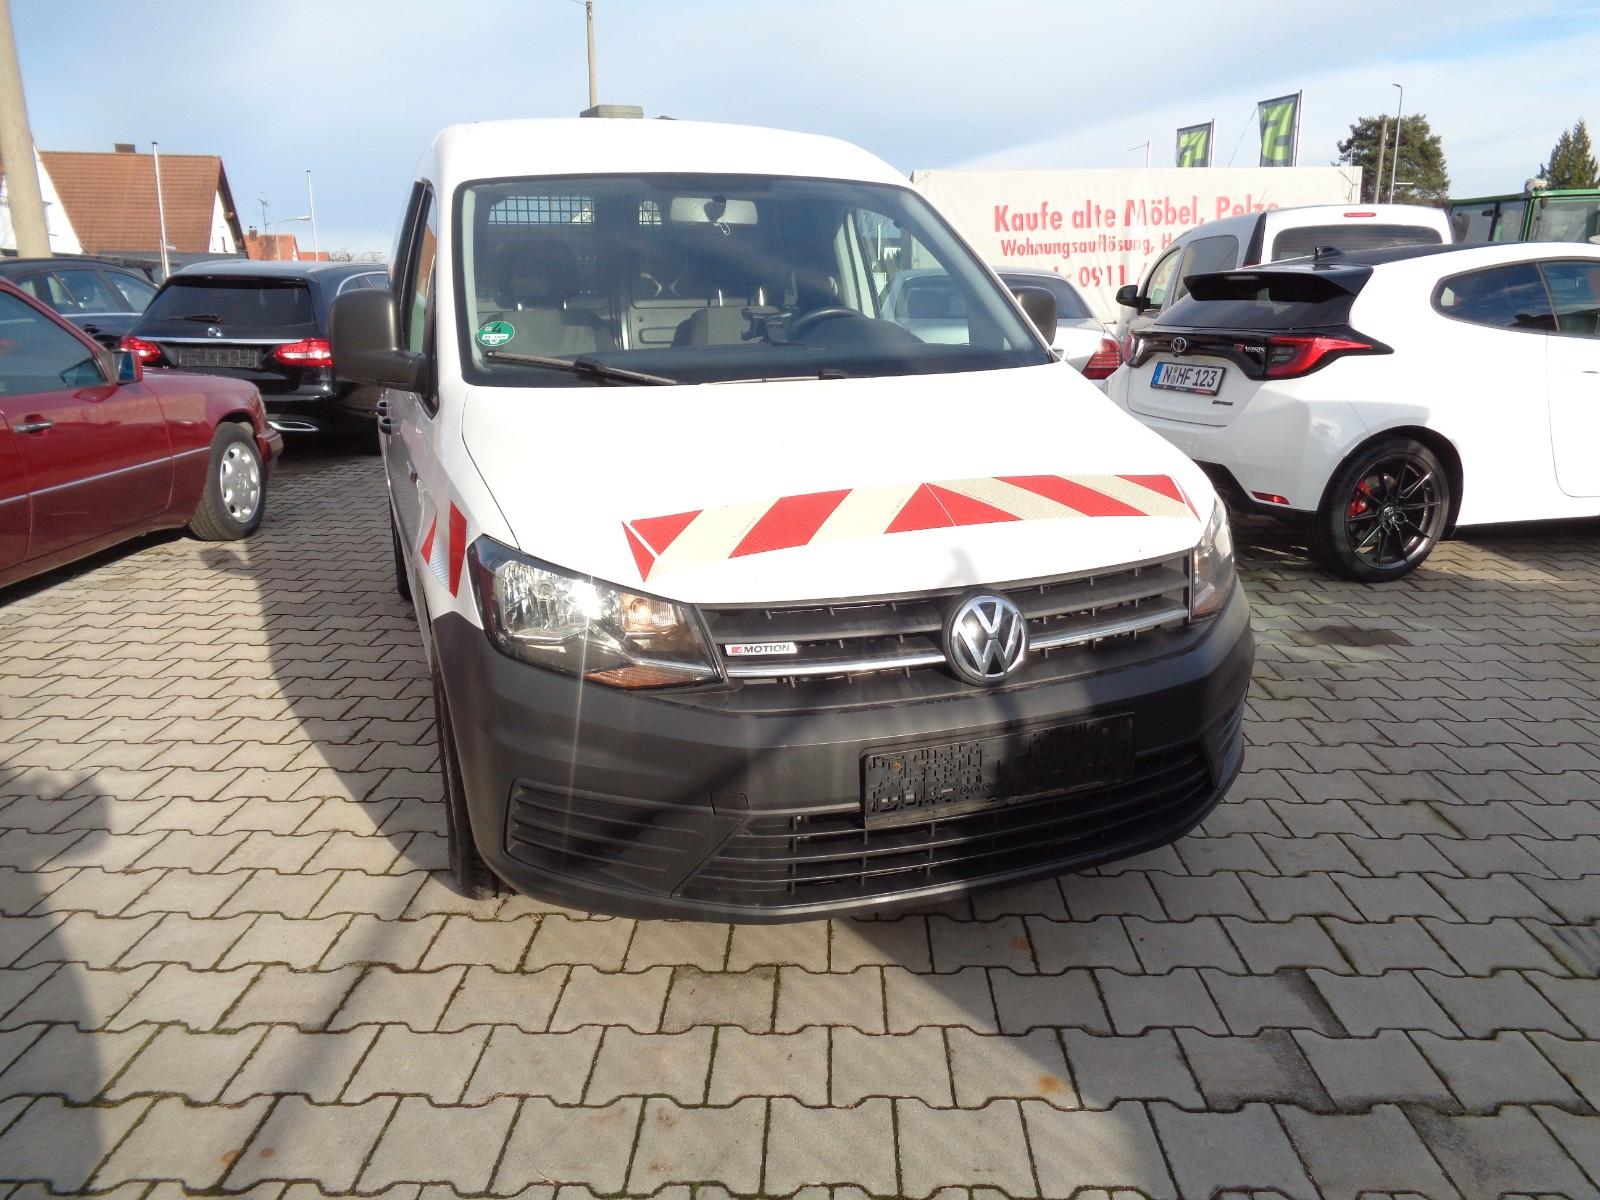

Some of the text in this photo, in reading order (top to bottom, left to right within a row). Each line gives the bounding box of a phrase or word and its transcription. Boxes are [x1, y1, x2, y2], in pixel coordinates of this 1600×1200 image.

[994, 201, 1063, 232] Kaufe
[1071, 199, 1117, 229] alte
[1123, 195, 1205, 226] Möbel,
[1000, 234, 1155, 260] Wohnungsauflösung,
[1192, 369, 1218, 388] 123
